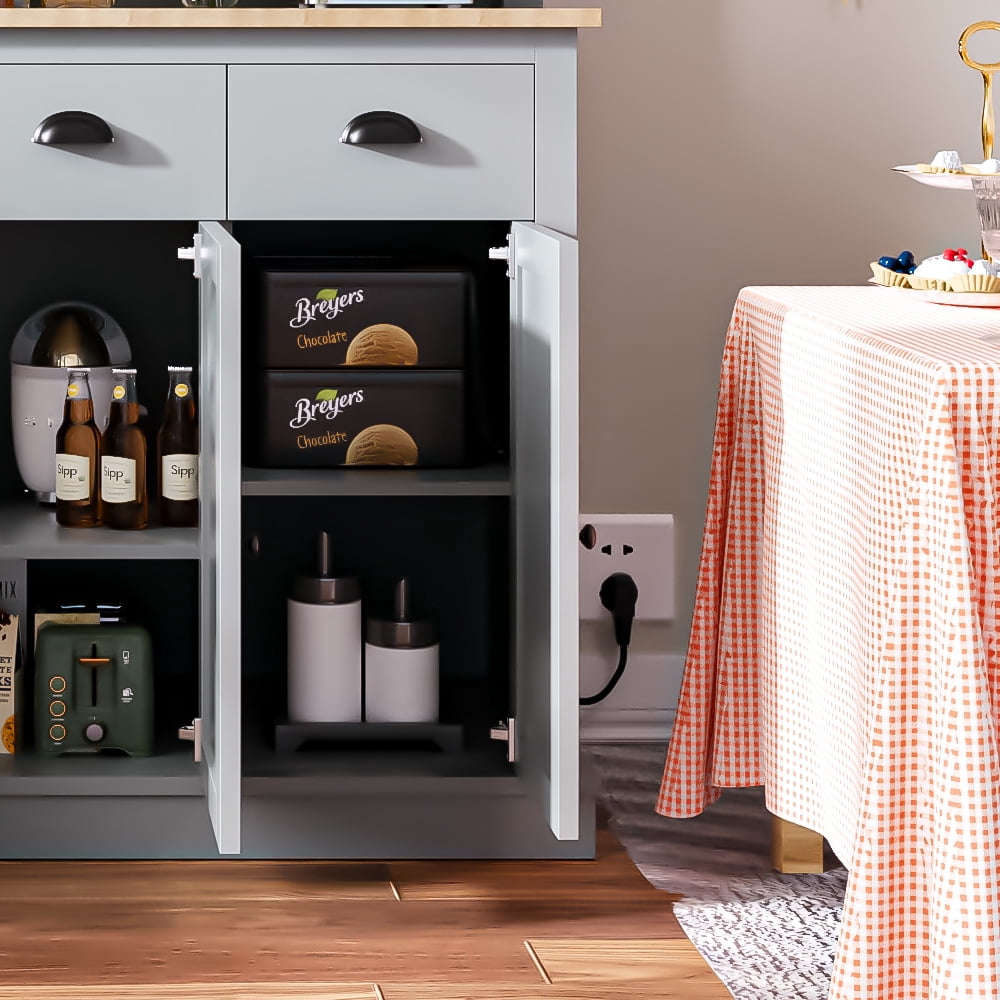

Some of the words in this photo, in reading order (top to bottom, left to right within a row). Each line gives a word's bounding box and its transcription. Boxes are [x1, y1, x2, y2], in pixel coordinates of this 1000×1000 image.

[289, 289, 364, 328] Breyers
[297, 330, 348, 349] Chocolate
[289, 389, 364, 429] Breyers
[297, 431, 348, 449] Chocolate
[57, 464, 78, 479] Sipp
[103, 466, 124, 482] Sipp
[171, 464, 195, 479] Sipp
